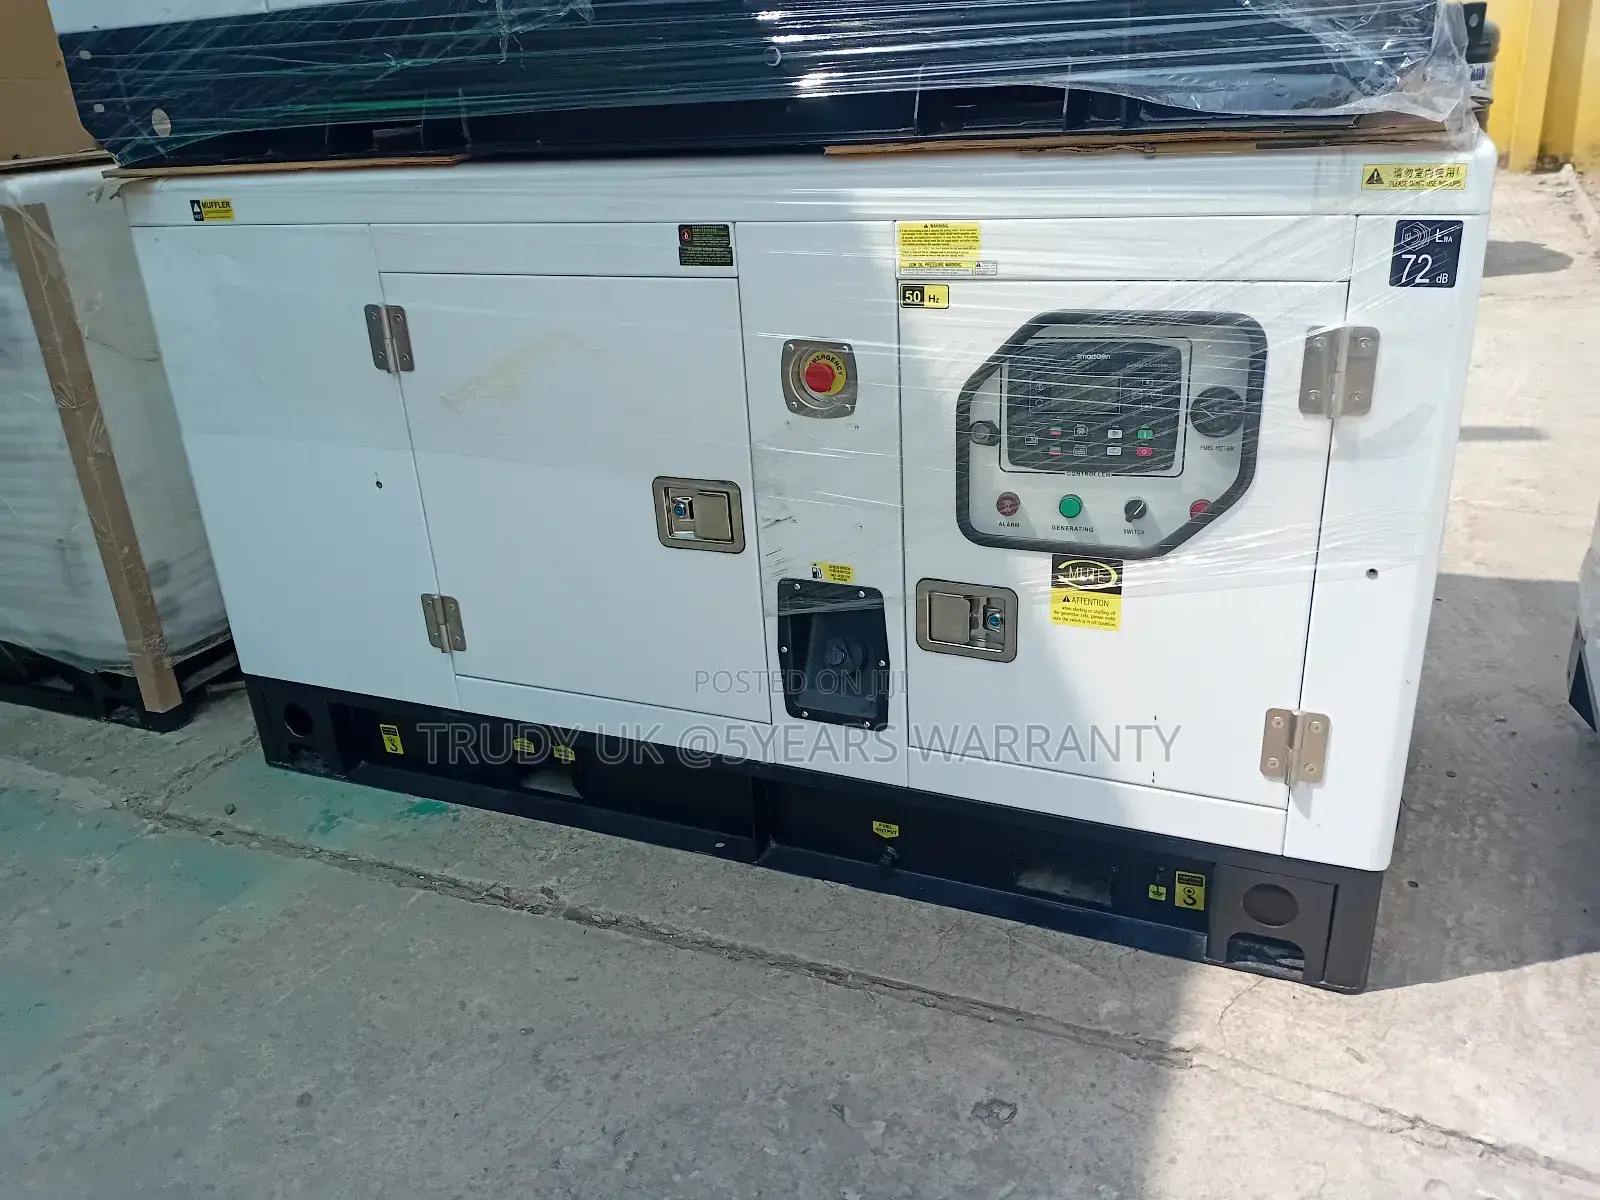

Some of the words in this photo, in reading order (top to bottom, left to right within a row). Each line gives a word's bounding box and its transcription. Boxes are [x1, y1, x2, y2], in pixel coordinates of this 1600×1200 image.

[1401, 253, 1433, 284] 72
[1435, 272, 1449, 284] dB
[904, 290, 922, 303] 50
[928, 294, 940, 303] Hz
[1067, 470, 1111, 478] CONTROLLER
[1051, 525, 1094, 533] GENERATING
[1123, 528, 1145, 536] SWITCH
[1068, 566, 1106, 584] MUTE
[1071, 596, 1110, 608] ATTENTION
[876, 827, 898, 835] OUTPUT
